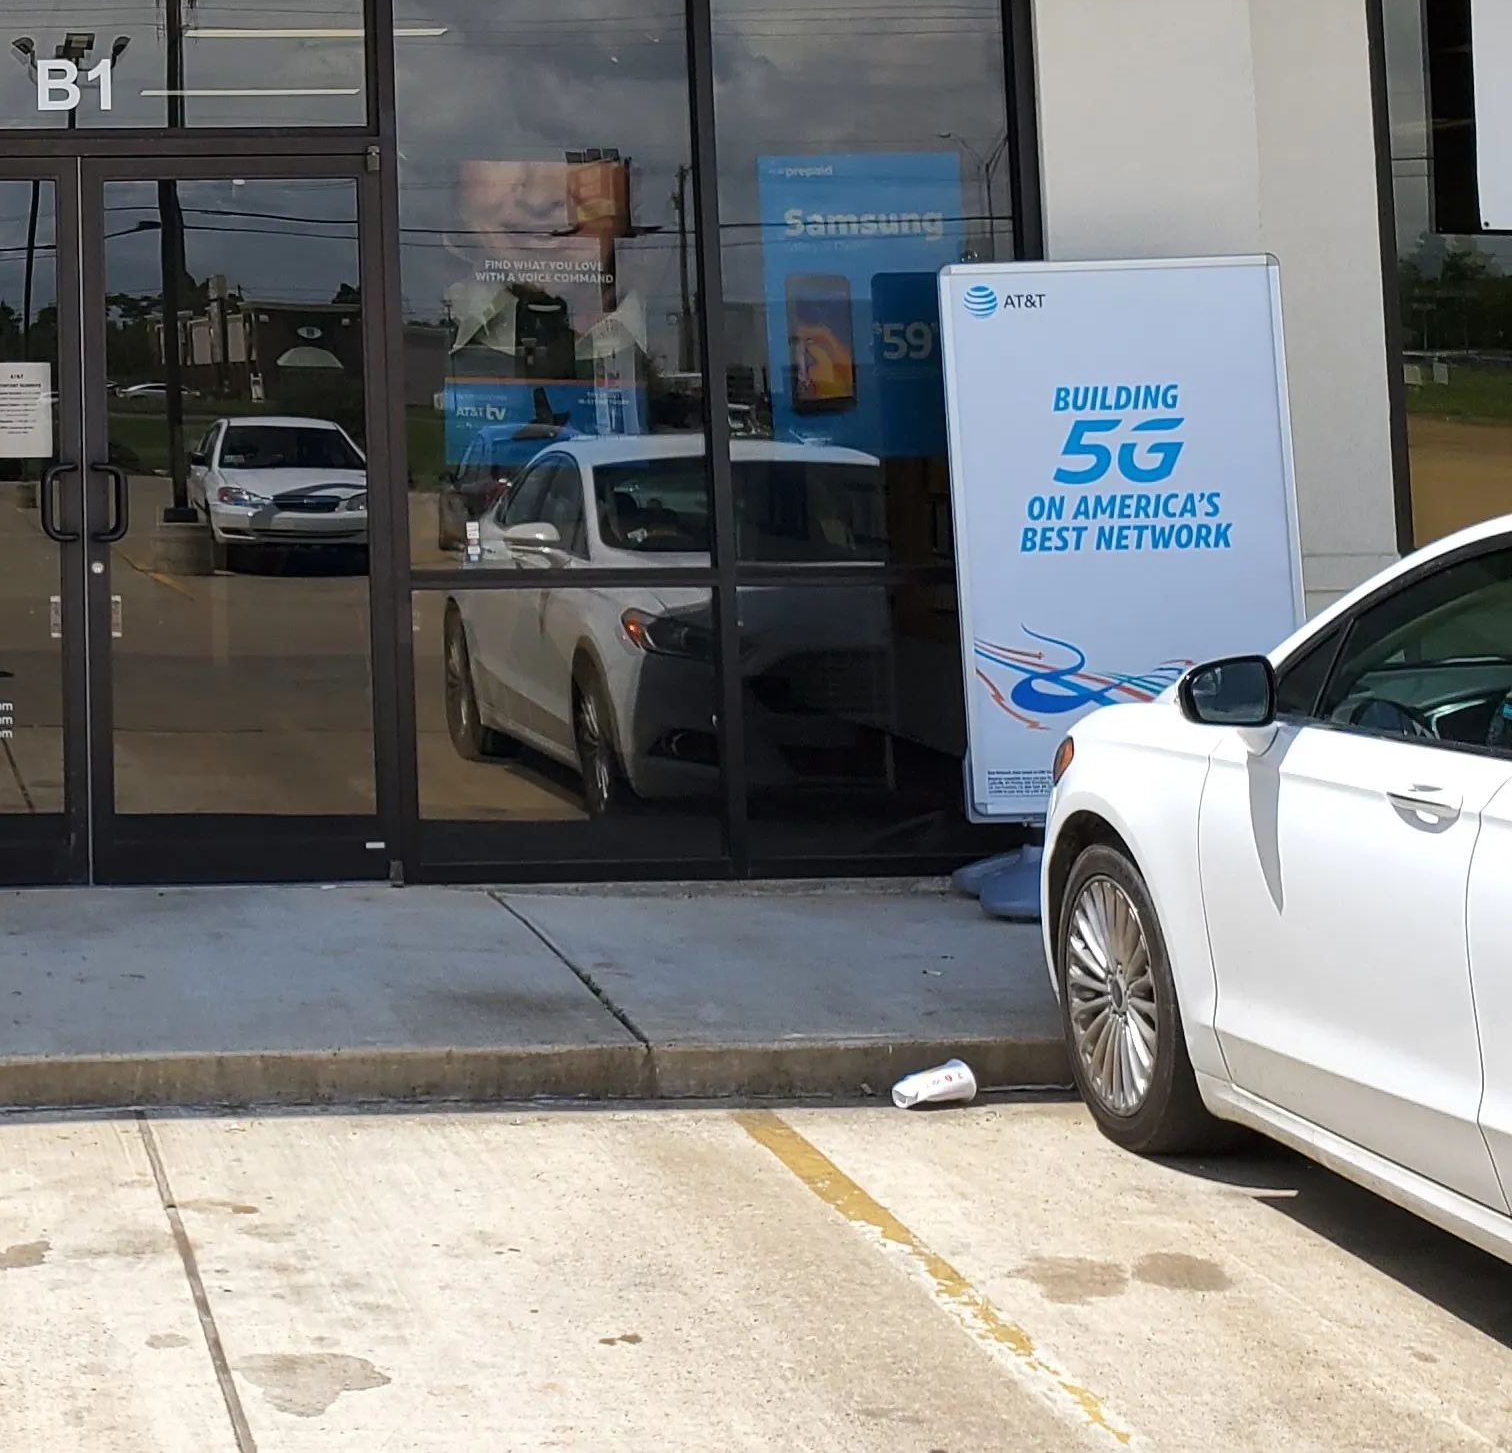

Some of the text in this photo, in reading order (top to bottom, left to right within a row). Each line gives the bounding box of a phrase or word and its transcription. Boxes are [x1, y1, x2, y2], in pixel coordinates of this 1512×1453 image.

[37, 58, 112, 111] B1
[786, 166, 833, 178] prepaid
[784, 209, 943, 241] Samsung
[475, 272, 614, 284] WITH A VOICE COMMAND
[484, 260, 604, 272] FIND WHAT YOU LOVE
[1004, 294, 1046, 309] AT&T
[456, 404, 506, 420] AT&T tv
[1053, 384, 1179, 412] BUILDING
[1053, 417, 1185, 484] 5G
[1027, 492, 1221, 521] ON AMERICA'S
[1020, 522, 1233, 552] BEST NETWORK
